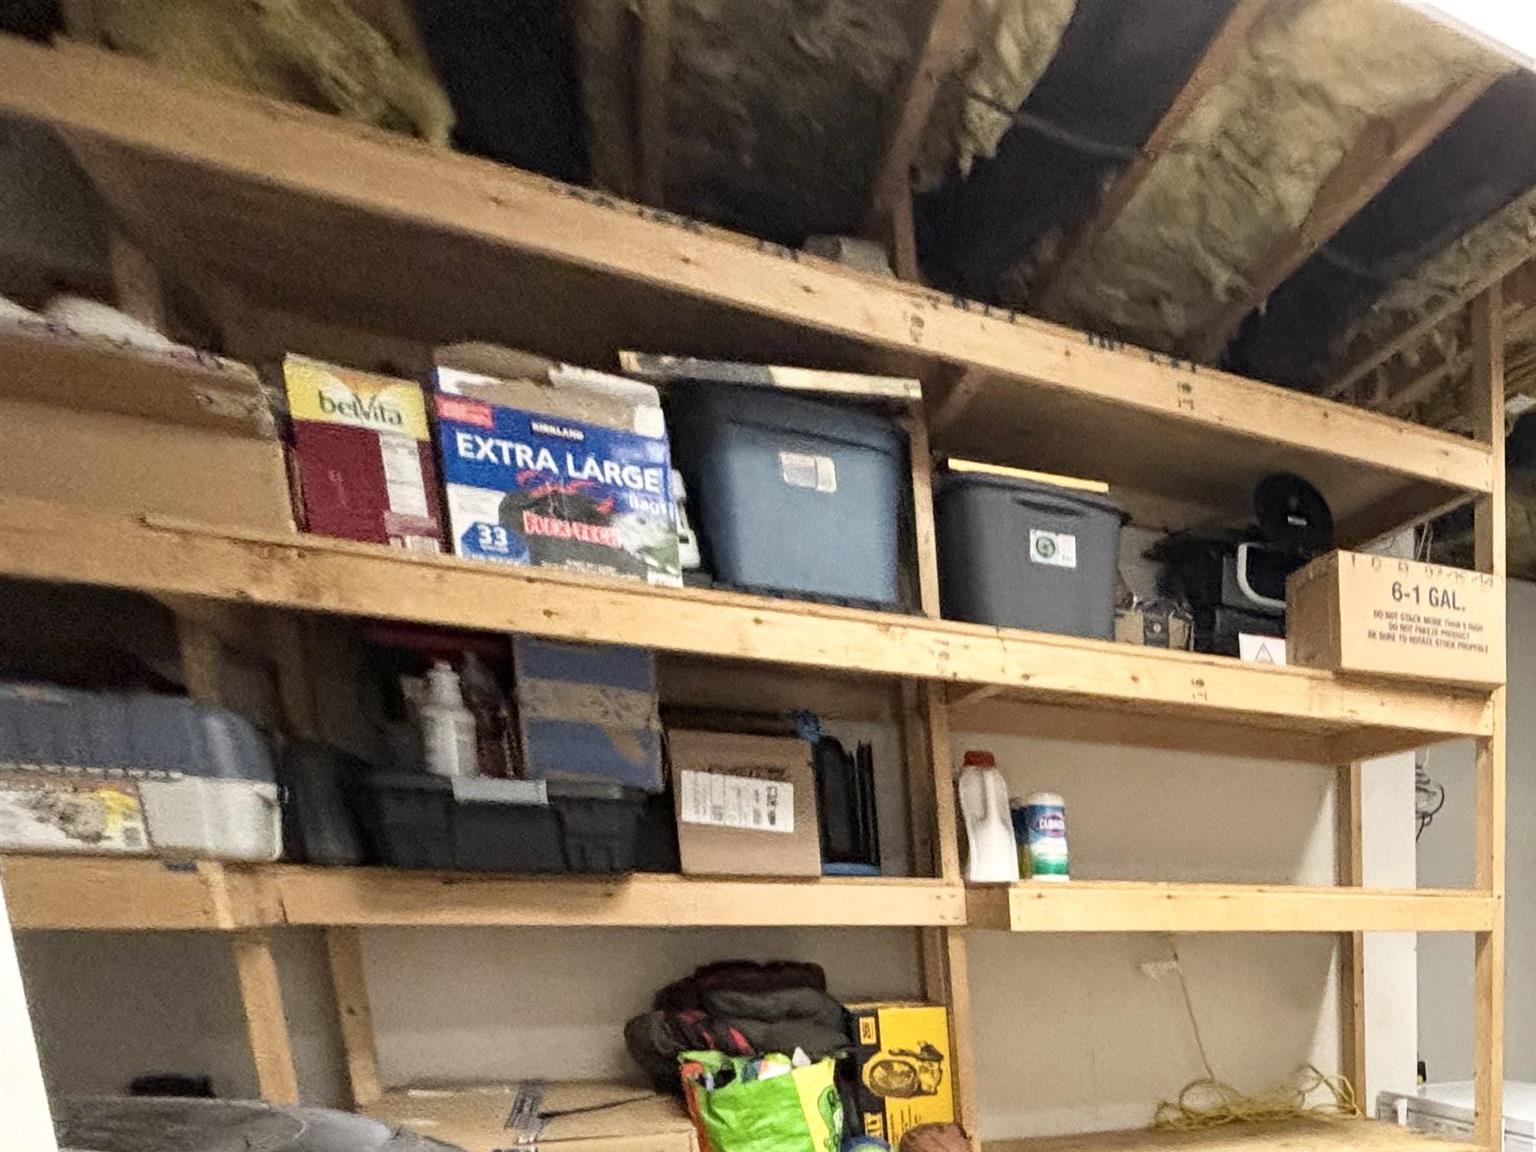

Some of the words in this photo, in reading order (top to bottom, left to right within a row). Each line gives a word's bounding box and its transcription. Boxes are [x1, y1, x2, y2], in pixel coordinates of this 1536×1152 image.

[455, 431, 560, 475] EXTRA
[565, 451, 664, 494] LARGE
[477, 525, 509, 548] 33
[1391, 581, 1421, 605] 6-1
[1428, 586, 1466, 612] GAL.
[1373, 609, 1384, 620] DO
[1384, 610, 1399, 621] NOT
[1400, 612, 1421, 624] STACK
[1367, 629, 1377, 640] BE
[1378, 631, 1396, 642] SURE
[1398, 633, 1407, 644] TO
[1408, 635, 1433, 647] ROTATE
[1435, 638, 1455, 649] STOCK
[1388, 621, 1398, 631] DO
[1400, 623, 1413, 633] NOT
[1440, 629, 1470, 641] PRODUCT
